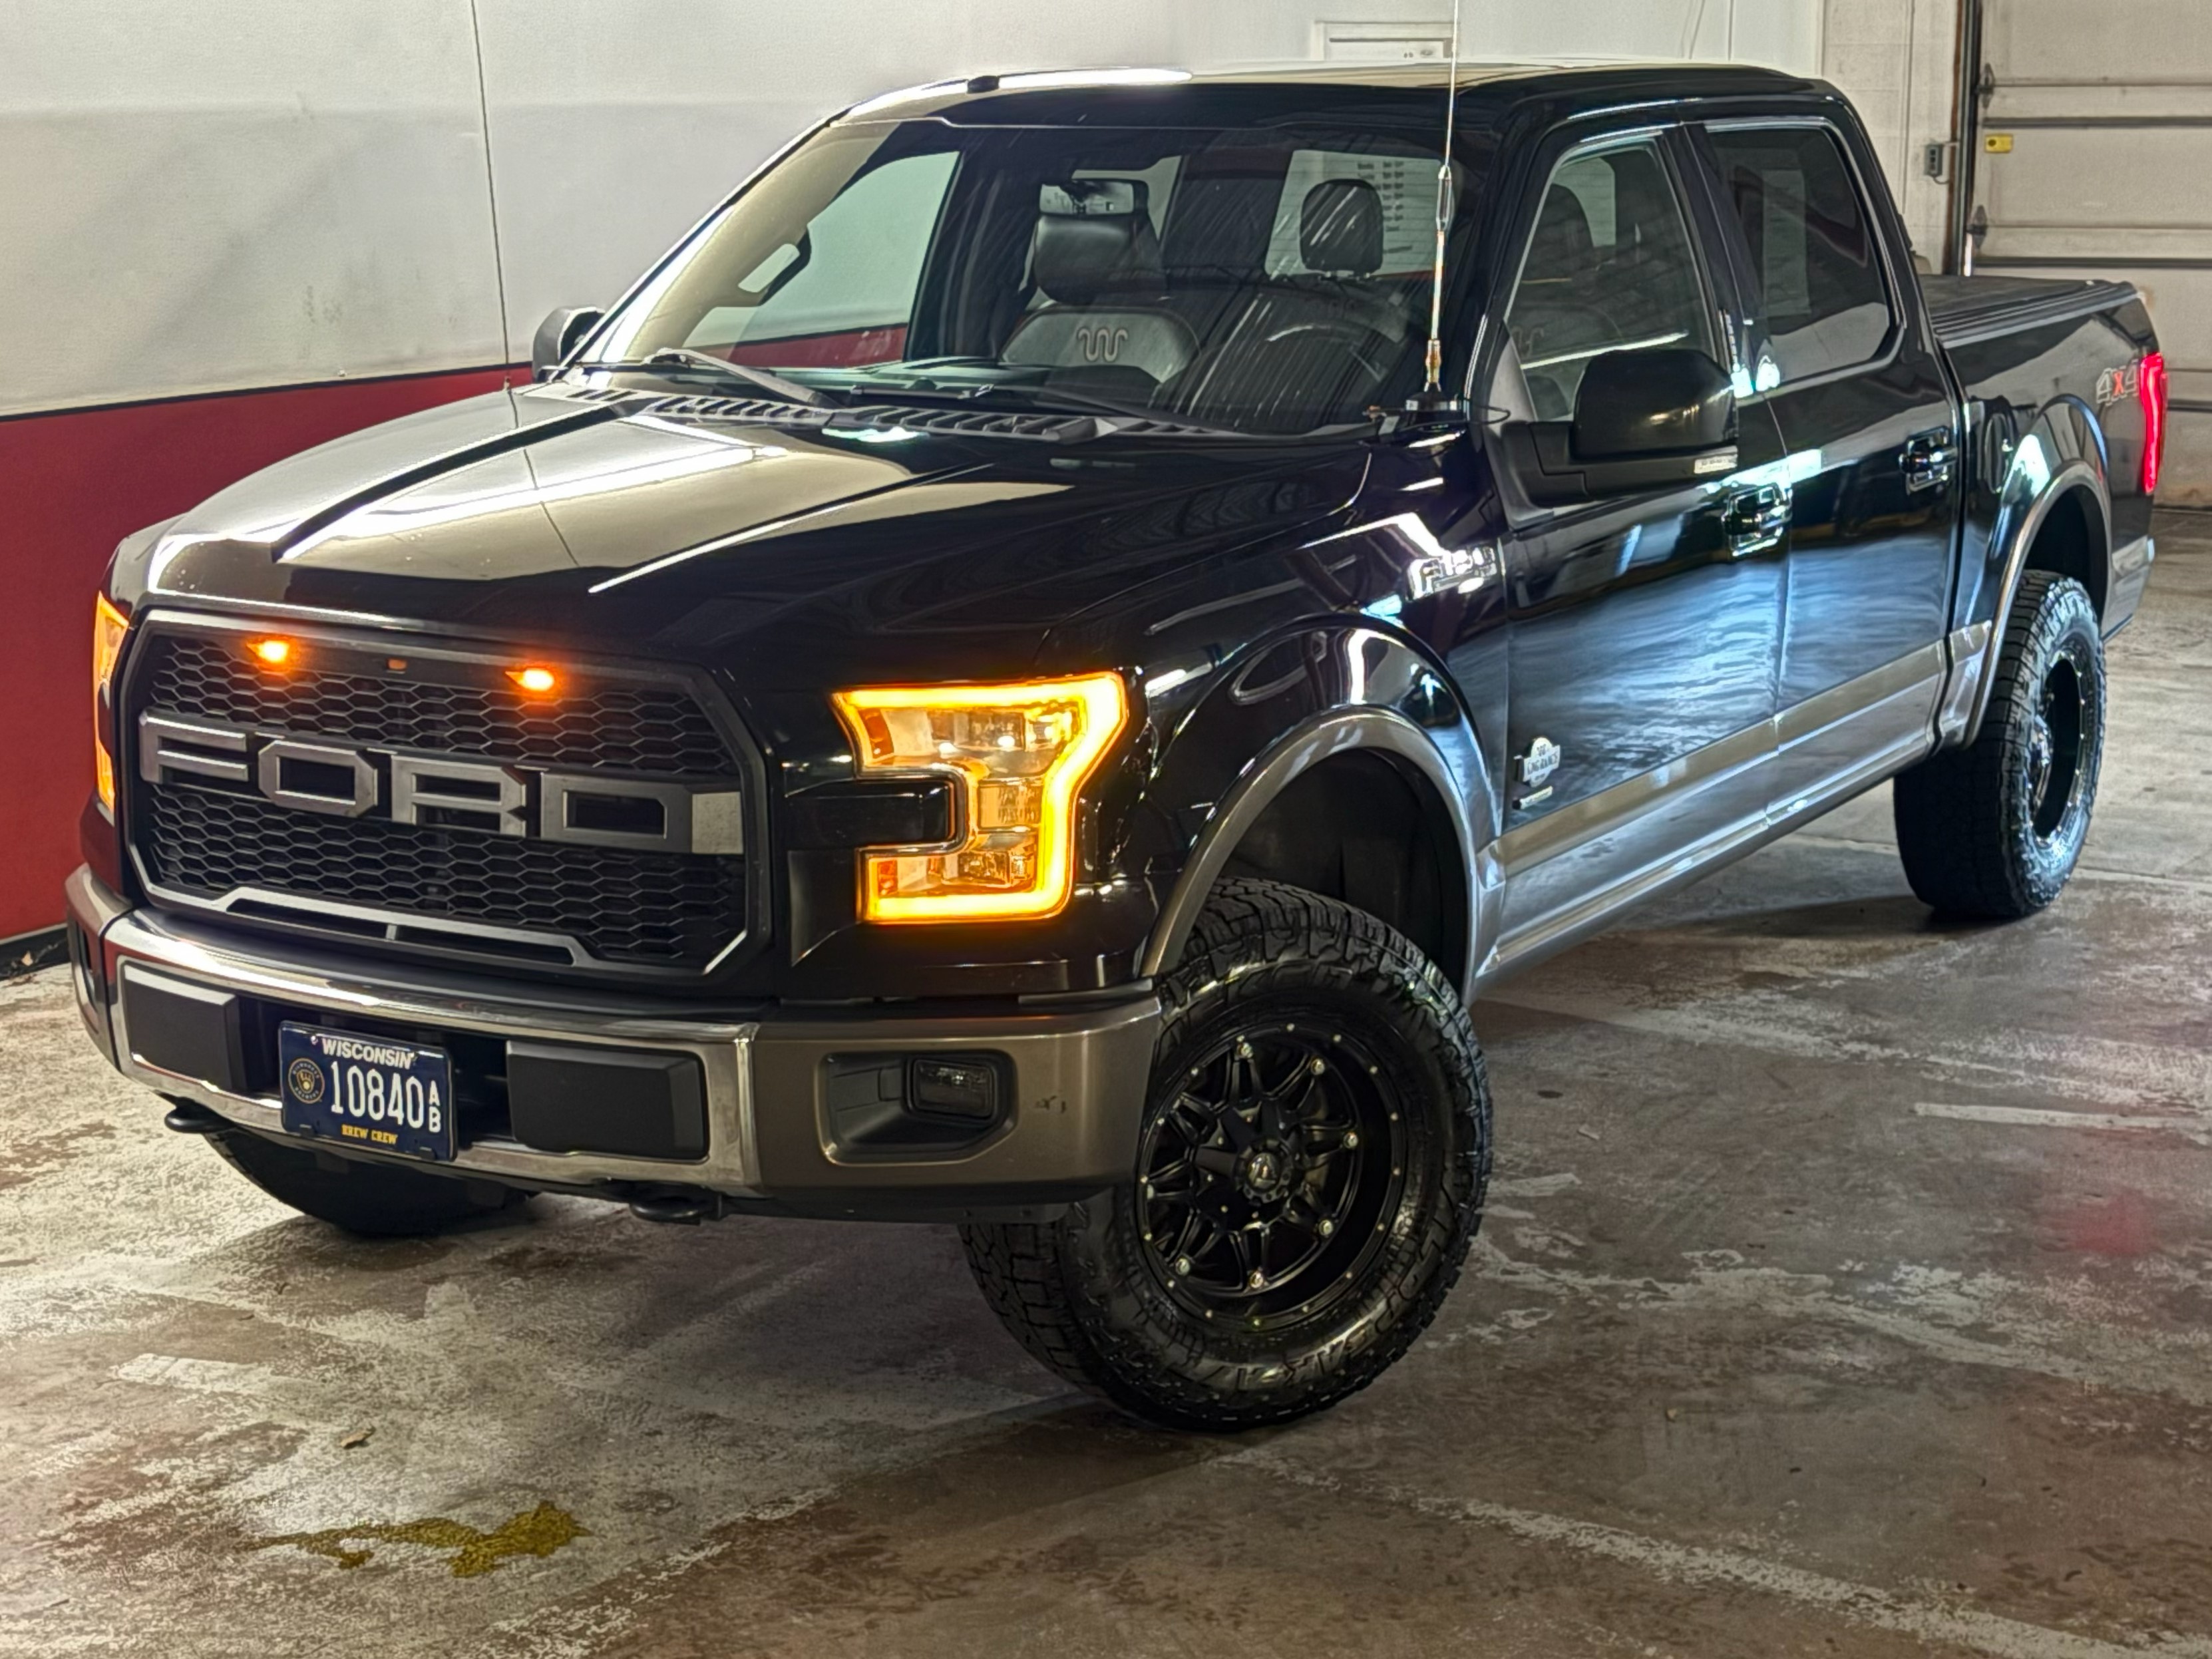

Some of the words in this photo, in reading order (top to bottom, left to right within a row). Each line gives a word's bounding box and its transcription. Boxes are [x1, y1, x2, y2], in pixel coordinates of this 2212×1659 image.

[139, 707, 693, 853] FORD
[322, 1038, 412, 1069] WISCONSIN
[331, 1061, 424, 1129] 10840
[341, 1124, 368, 1141] BREW
[371, 1129, 399, 1145] CREW
